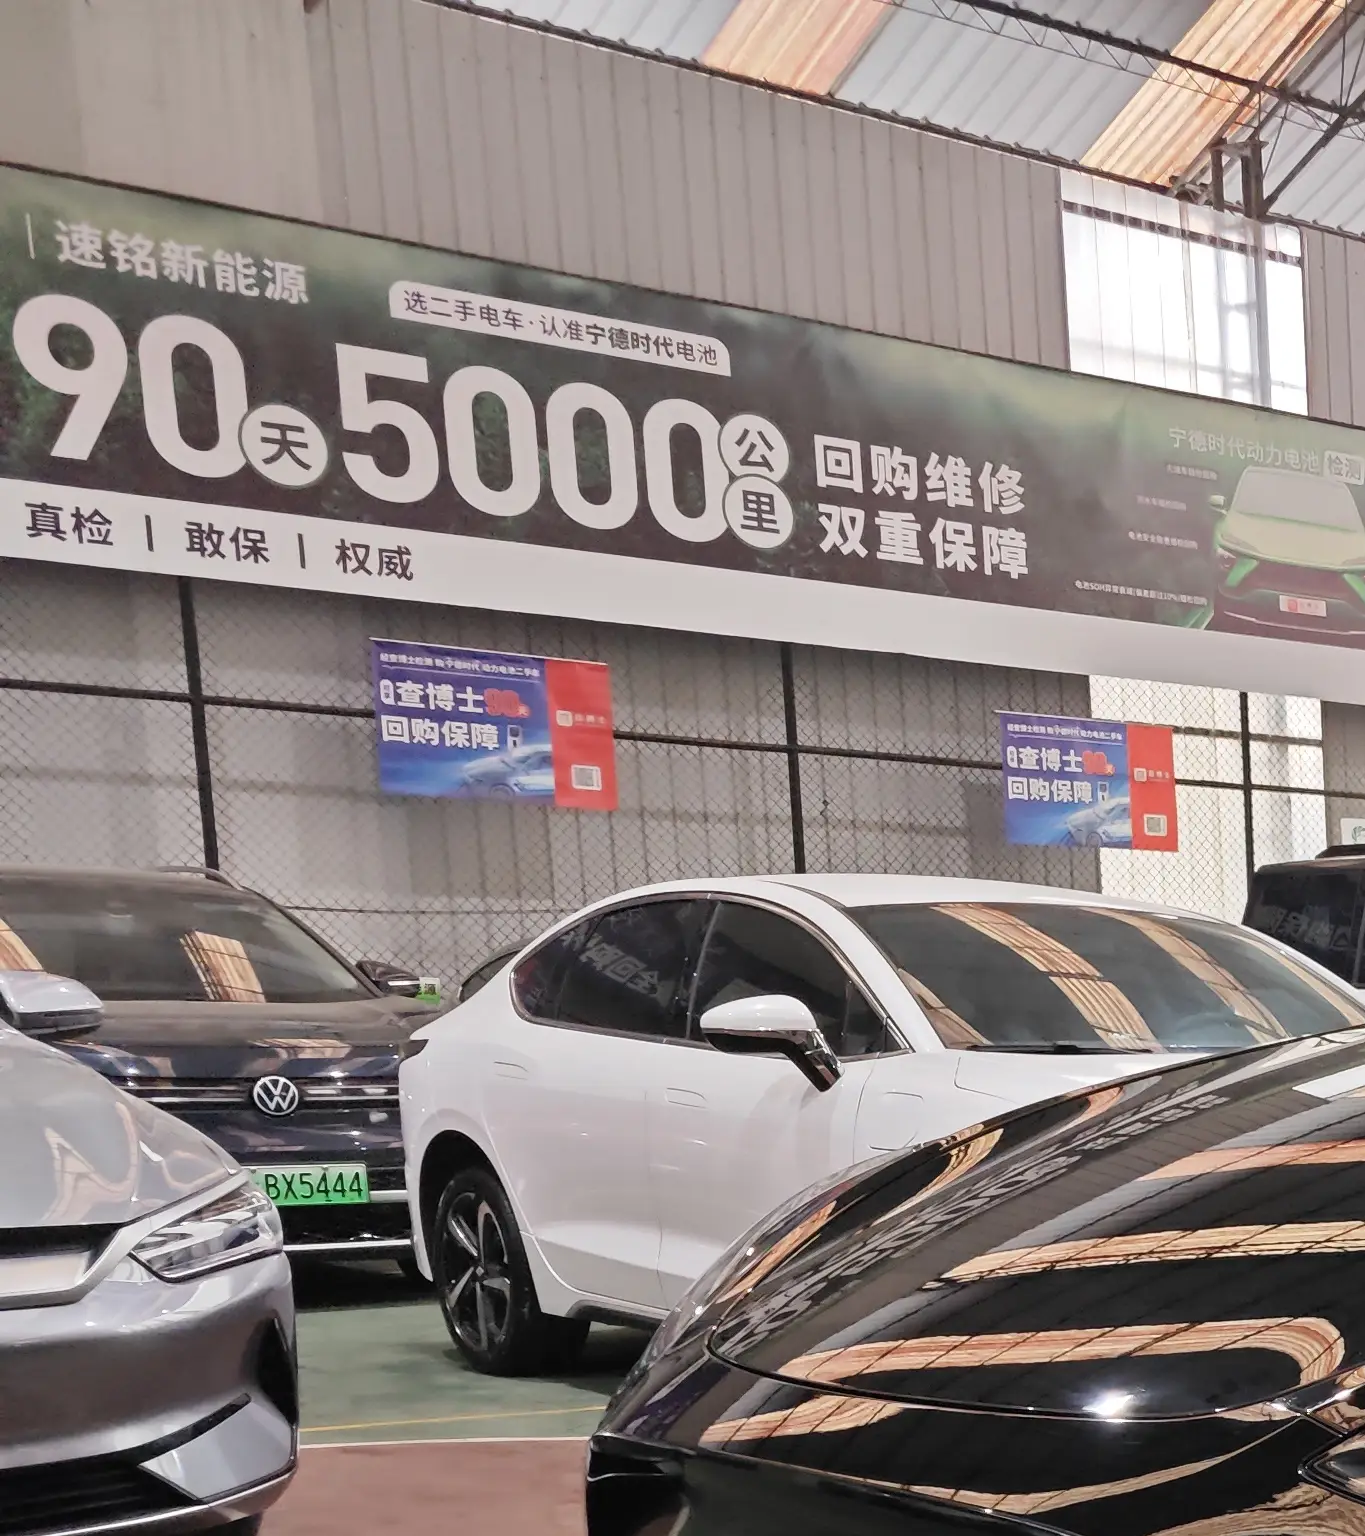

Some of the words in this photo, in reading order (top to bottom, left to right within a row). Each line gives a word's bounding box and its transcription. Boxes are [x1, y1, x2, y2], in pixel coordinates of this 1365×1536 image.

[54, 219, 310, 306] 速铭新能源
[813, 433, 1027, 517] 回购维修
[24, 502, 114, 547] 真检
[185, 520, 270, 564] 敢保
[335, 537, 414, 582] 权威
[817, 505, 1029, 580] 双重保障
[380, 714, 500, 751] 回购保障
[1007, 776, 1093, 805] 回购保障
[264, 1171, 363, 1200] BX5444
